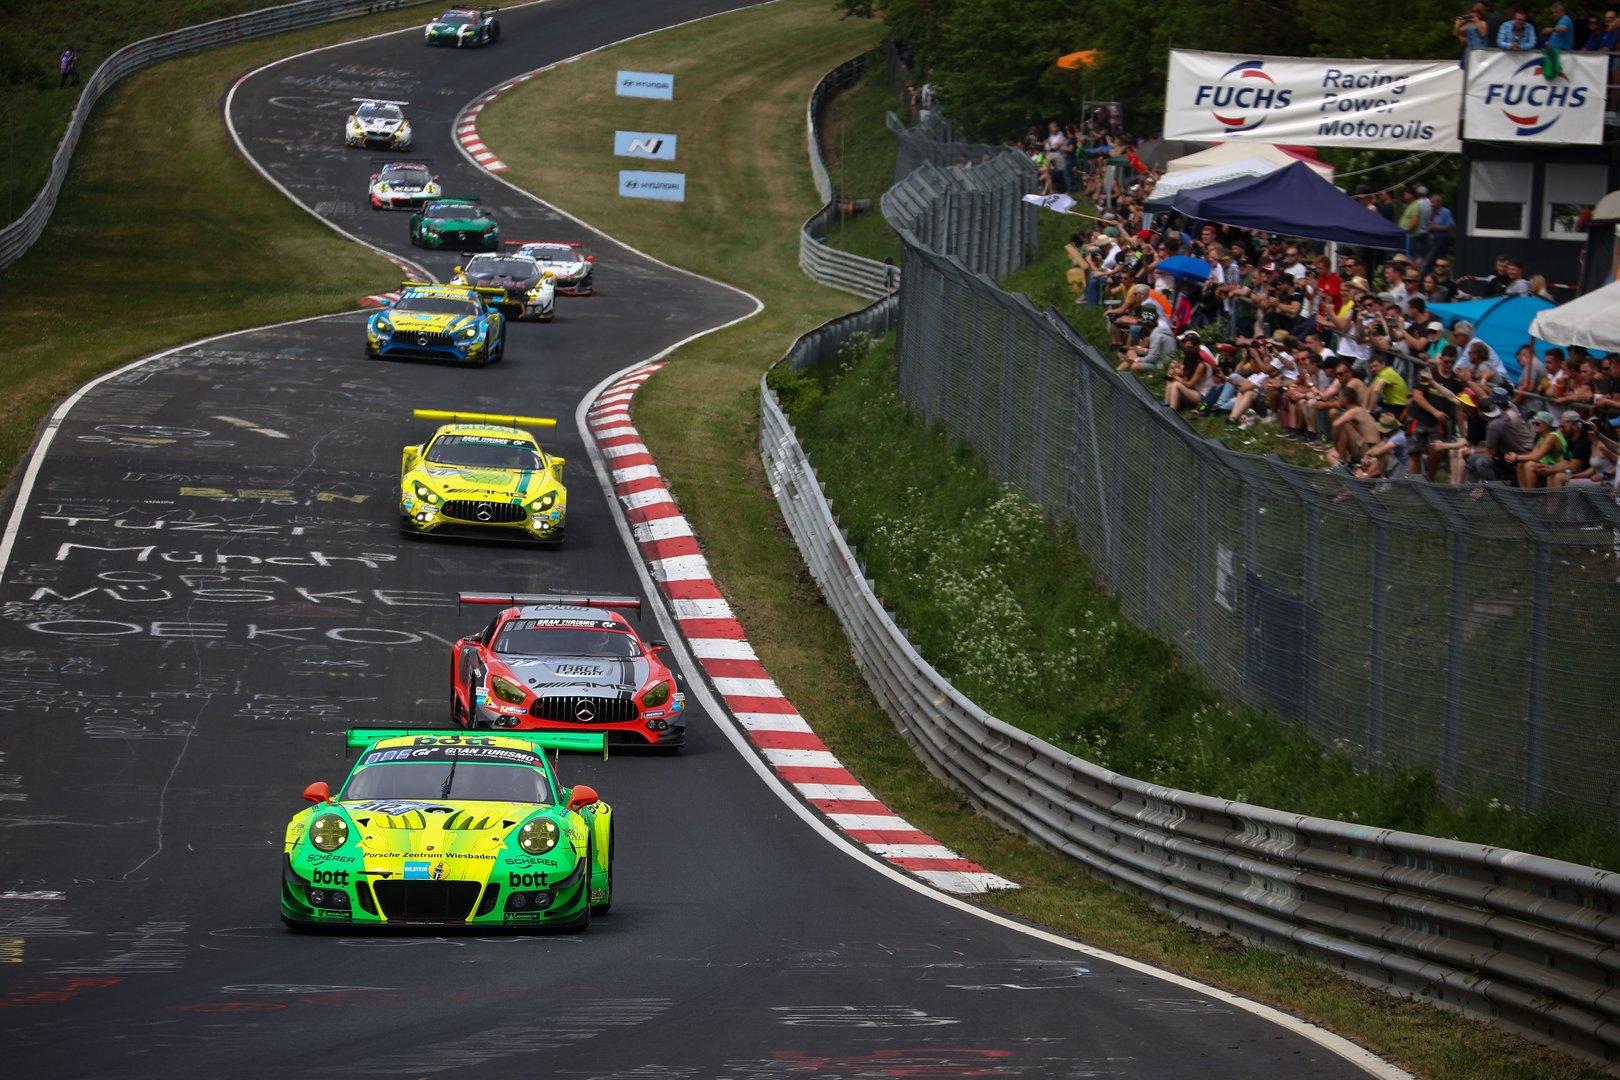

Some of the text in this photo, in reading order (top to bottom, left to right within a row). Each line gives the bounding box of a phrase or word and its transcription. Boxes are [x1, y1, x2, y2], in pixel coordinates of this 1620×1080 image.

[1322, 69, 1409, 94] Racing
[1194, 85, 1292, 109] FUCHS
[1320, 93, 1401, 113] Power
[1484, 84, 1588, 108] FUCHS
[1317, 117, 1435, 140] Motoroils
[482, 748, 535, 762] TURISMO
[306, 854, 356, 864] SCHERER
[445, 852, 497, 860] Wiesbaden
[504, 857, 558, 868] SCHERER
[313, 868, 349, 886] bott
[509, 871, 549, 888] bott
